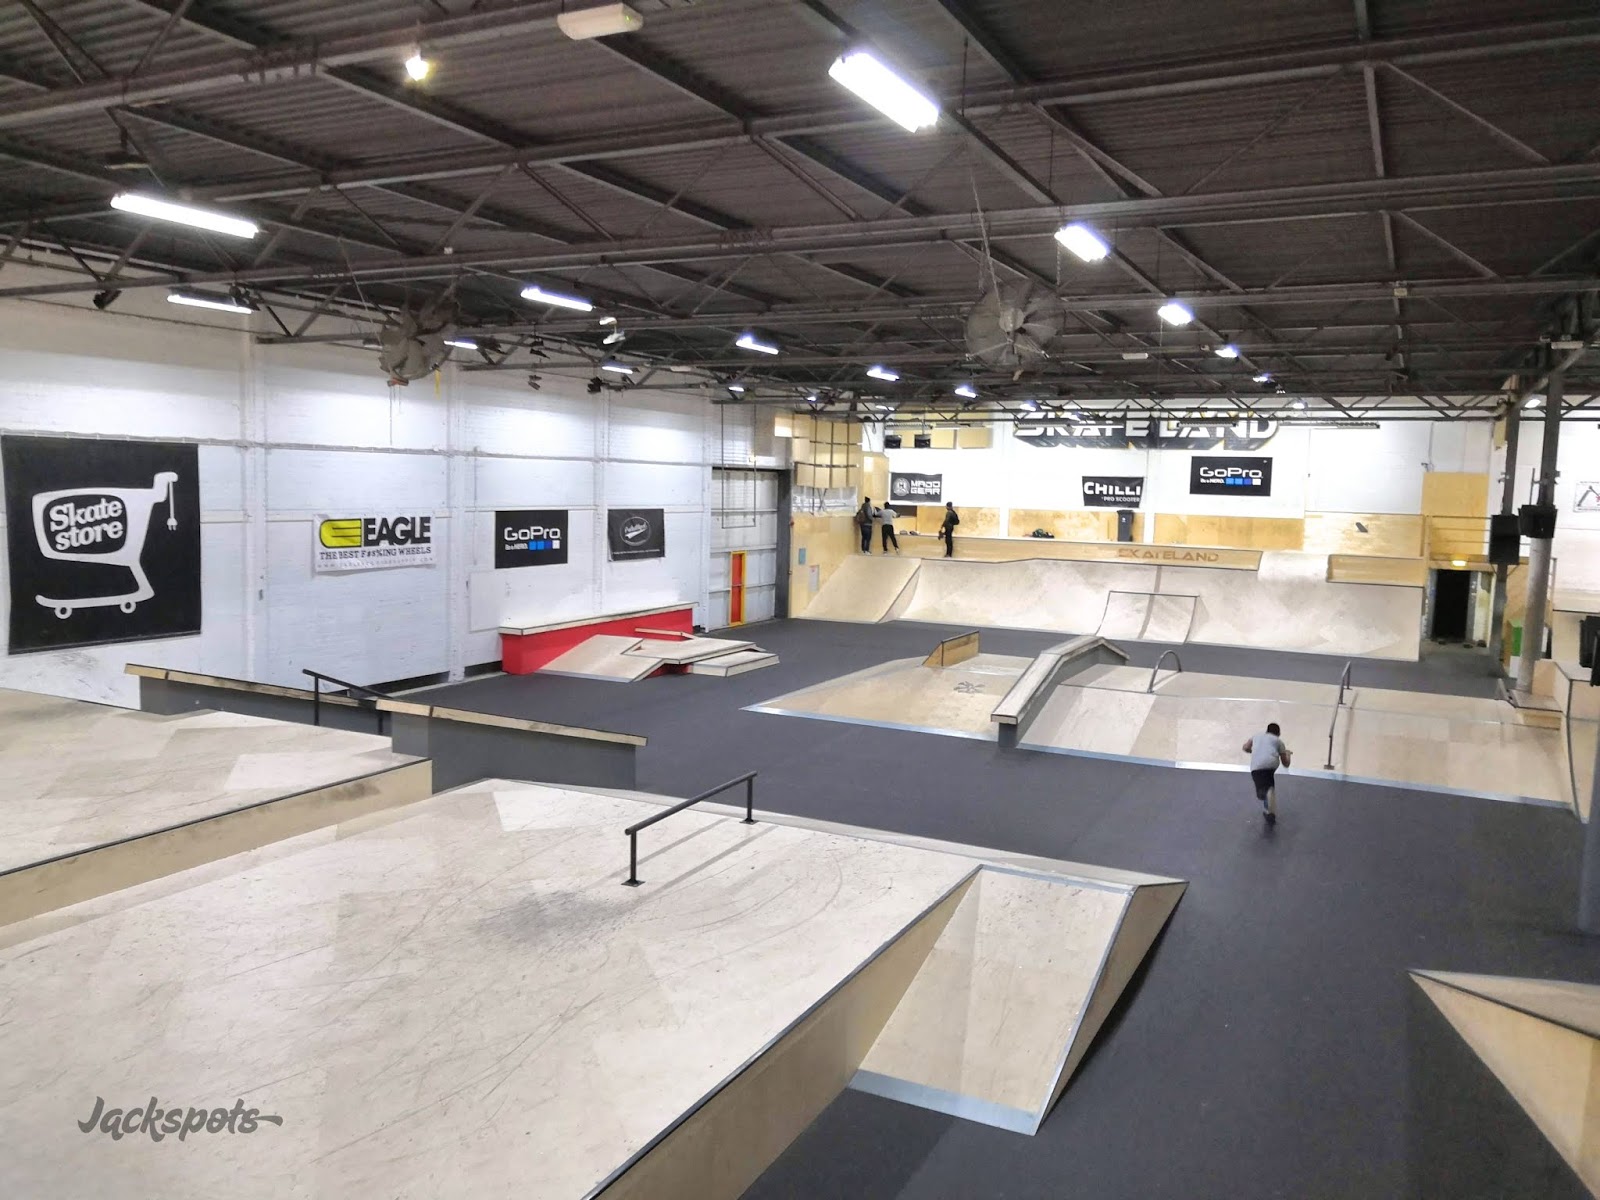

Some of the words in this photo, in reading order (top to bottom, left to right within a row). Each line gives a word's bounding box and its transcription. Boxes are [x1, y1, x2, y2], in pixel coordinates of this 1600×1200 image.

[1199, 467, 1263, 478] GoPro
[910, 487, 941, 495] GEAR
[1084, 481, 1141, 496] CHILLI
[49, 497, 123, 532] Skate
[55, 520, 124, 551] store
[363, 516, 431, 547] EAGLE
[504, 526, 562, 541] GoPro
[320, 551, 338, 560] THE
[339, 550, 360, 559] BEST
[398, 546, 432, 556] WHEELS
